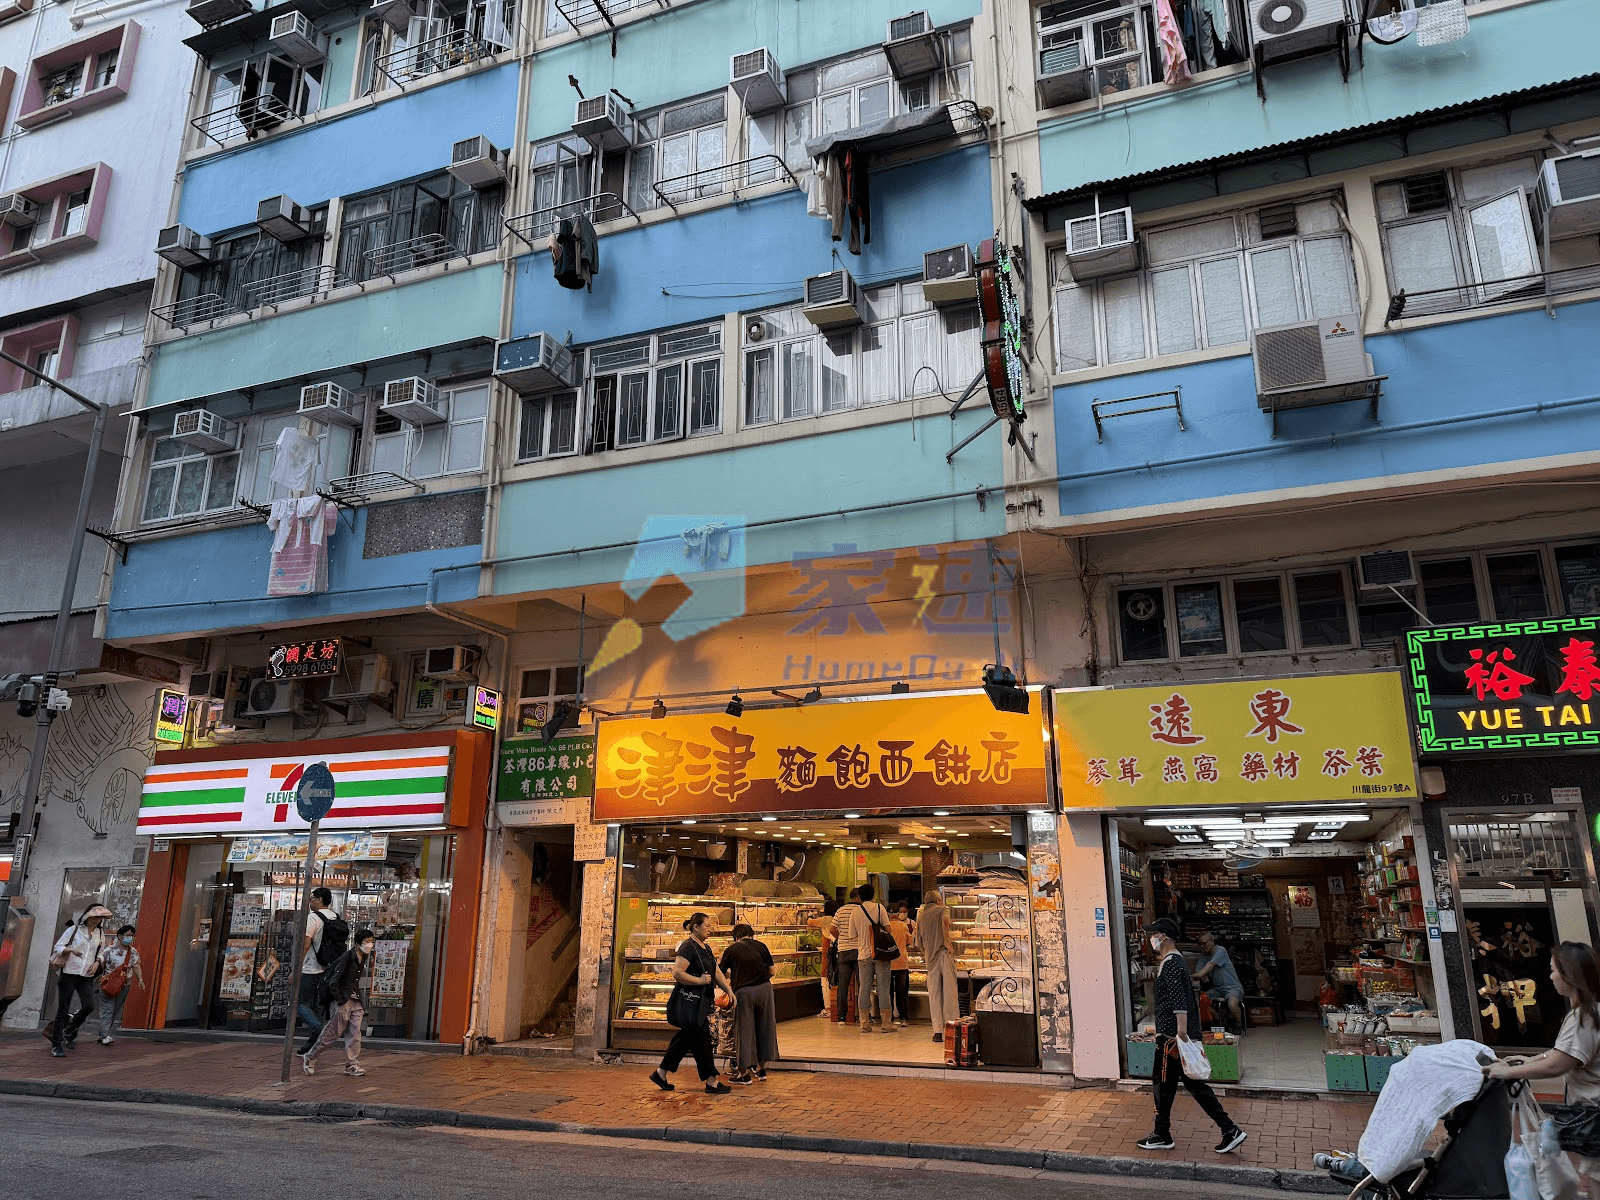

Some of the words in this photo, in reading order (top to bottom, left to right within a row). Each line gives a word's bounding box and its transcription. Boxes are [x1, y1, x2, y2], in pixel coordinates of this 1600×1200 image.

[285, 664, 308, 675] 5998
[310, 660, 333, 672] 6168
[1464, 637, 1600, 700] 裕泰
[1150, 690, 1303, 744] 遠東
[1457, 708, 1523, 731] YUE
[1536, 703, 1592, 727] TAI
[531, 745, 547, 753] Route
[549, 744, 558, 752] No.
[616, 724, 756, 806] 津津
[776, 731, 1019, 795] 麵飽西餅店
[1162, 753, 1219, 783] 燕窩
[1239, 750, 1300, 782] 藥材
[1322, 746, 1384, 777] 茶葉
[270, 763, 304, 822] 7
[520, 775, 577, 794] 有限公司
[1501, 793, 1534, 806] 97B
[1331, 878, 1341, 888] 12
[1294, 887, 1314, 907] 福
